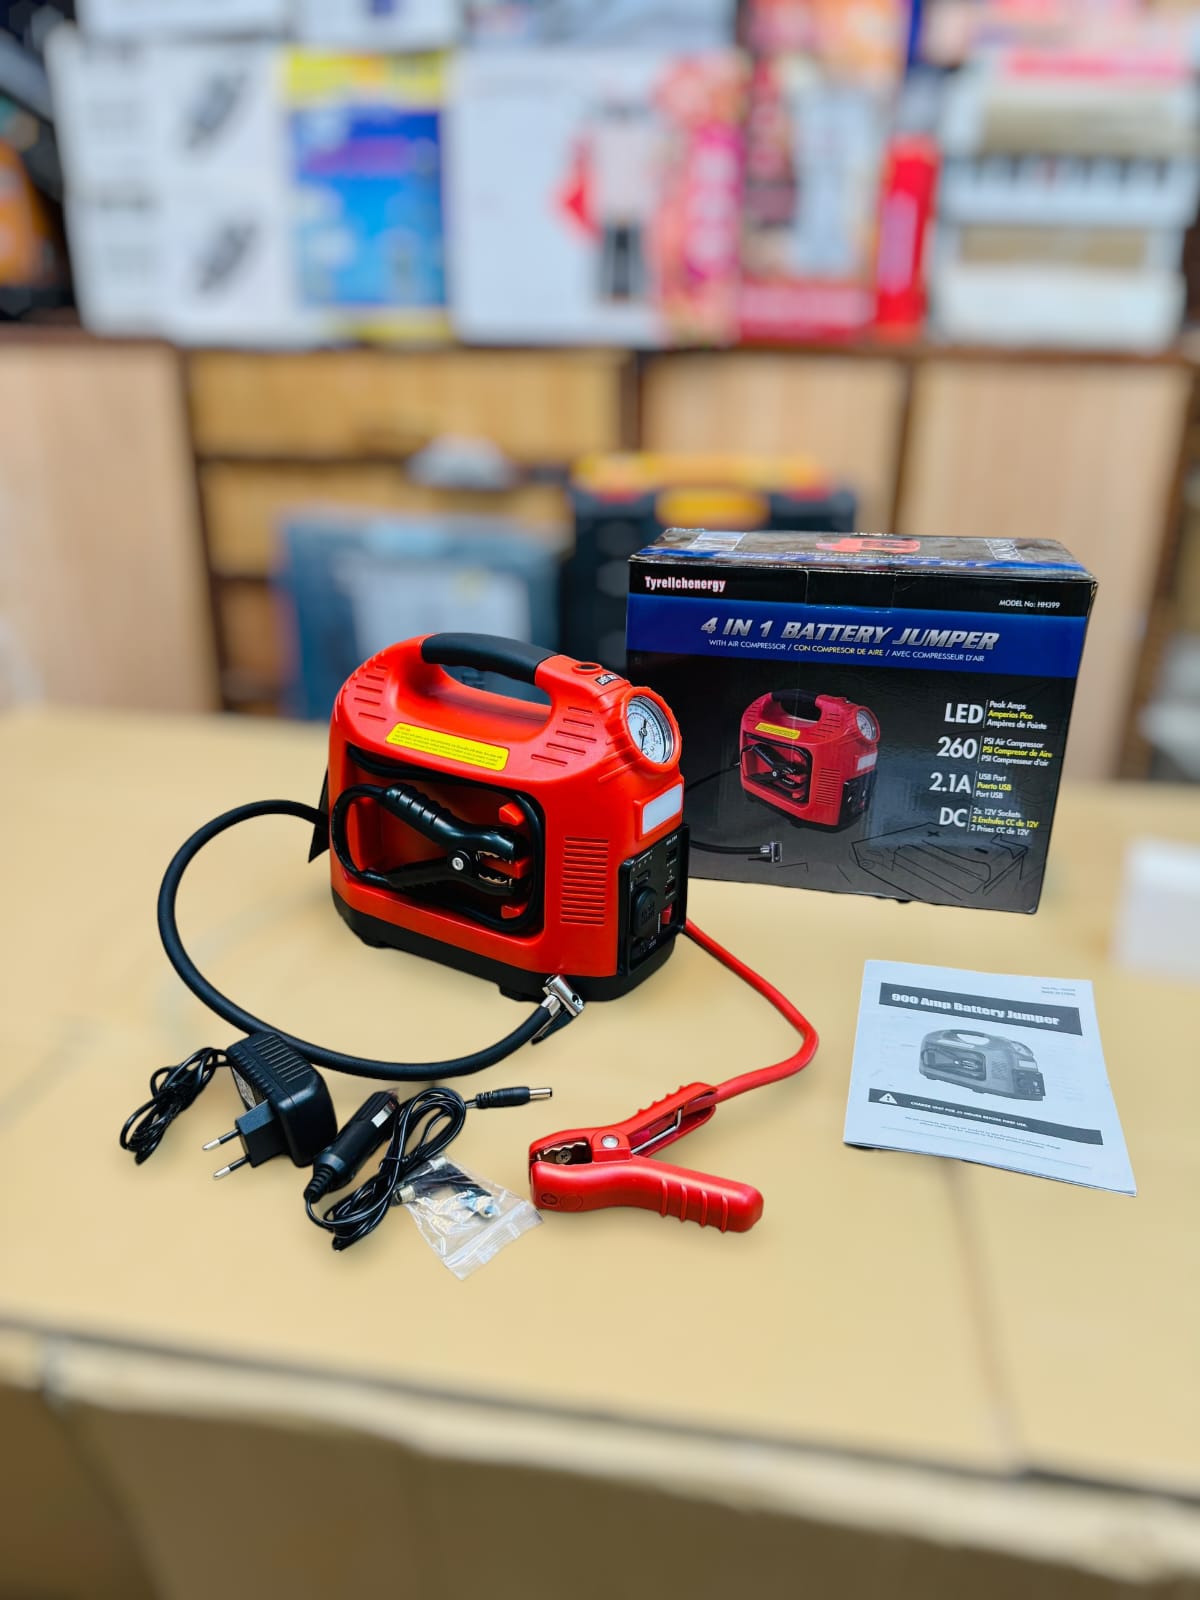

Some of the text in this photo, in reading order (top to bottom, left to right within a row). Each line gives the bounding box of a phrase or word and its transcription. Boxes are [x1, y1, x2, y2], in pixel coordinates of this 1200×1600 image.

[999, 599, 1023, 607] MODEL
[700, 617, 1000, 650] 4 IN 1 BATTERY JUMPER
[709, 639, 727, 647] WITH
[728, 640, 739, 648] AIR
[740, 641, 786, 650] COMPRESSOR
[787, 643, 793, 651] /
[793, 644, 811, 652] CON
[812, 645, 855, 654] COMPRESOR
[867, 648, 883, 656] AIRE
[885, 649, 890, 657] /
[891, 650, 911, 658] AVEC
[912, 651, 964, 661] COMPRESSEUR
[965, 653, 985, 662] D'AIR
[989, 700, 1027, 711] Peak Amps
[944, 702, 984, 725] LED
[988, 710, 1033, 719] Amperios Pico
[987, 718, 1048, 730] Ampères de Pointe
[936, 736, 977, 760] 260
[995, 738, 1006, 746] Air
[1006, 739, 1044, 749] Compressor
[993, 746, 1028, 756] Compresor
[992, 756, 1033, 765] Compresseur
[978, 773, 992, 781] USB
[929, 772, 972, 794] 2.1A
[976, 781, 1012, 791] Puerto USB
[975, 790, 989, 798] Port
[939, 807, 968, 828] DC
[984, 808, 997, 816] 12V
[1016, 819, 1025, 827] de
[1026, 820, 1040, 828] 12V
[976, 824, 995, 833] Prises
[1006, 827, 1015, 835] de
[1017, 828, 1030, 836] 12V
[892, 993, 1060, 1025] 900 Amp Battery Jumper
